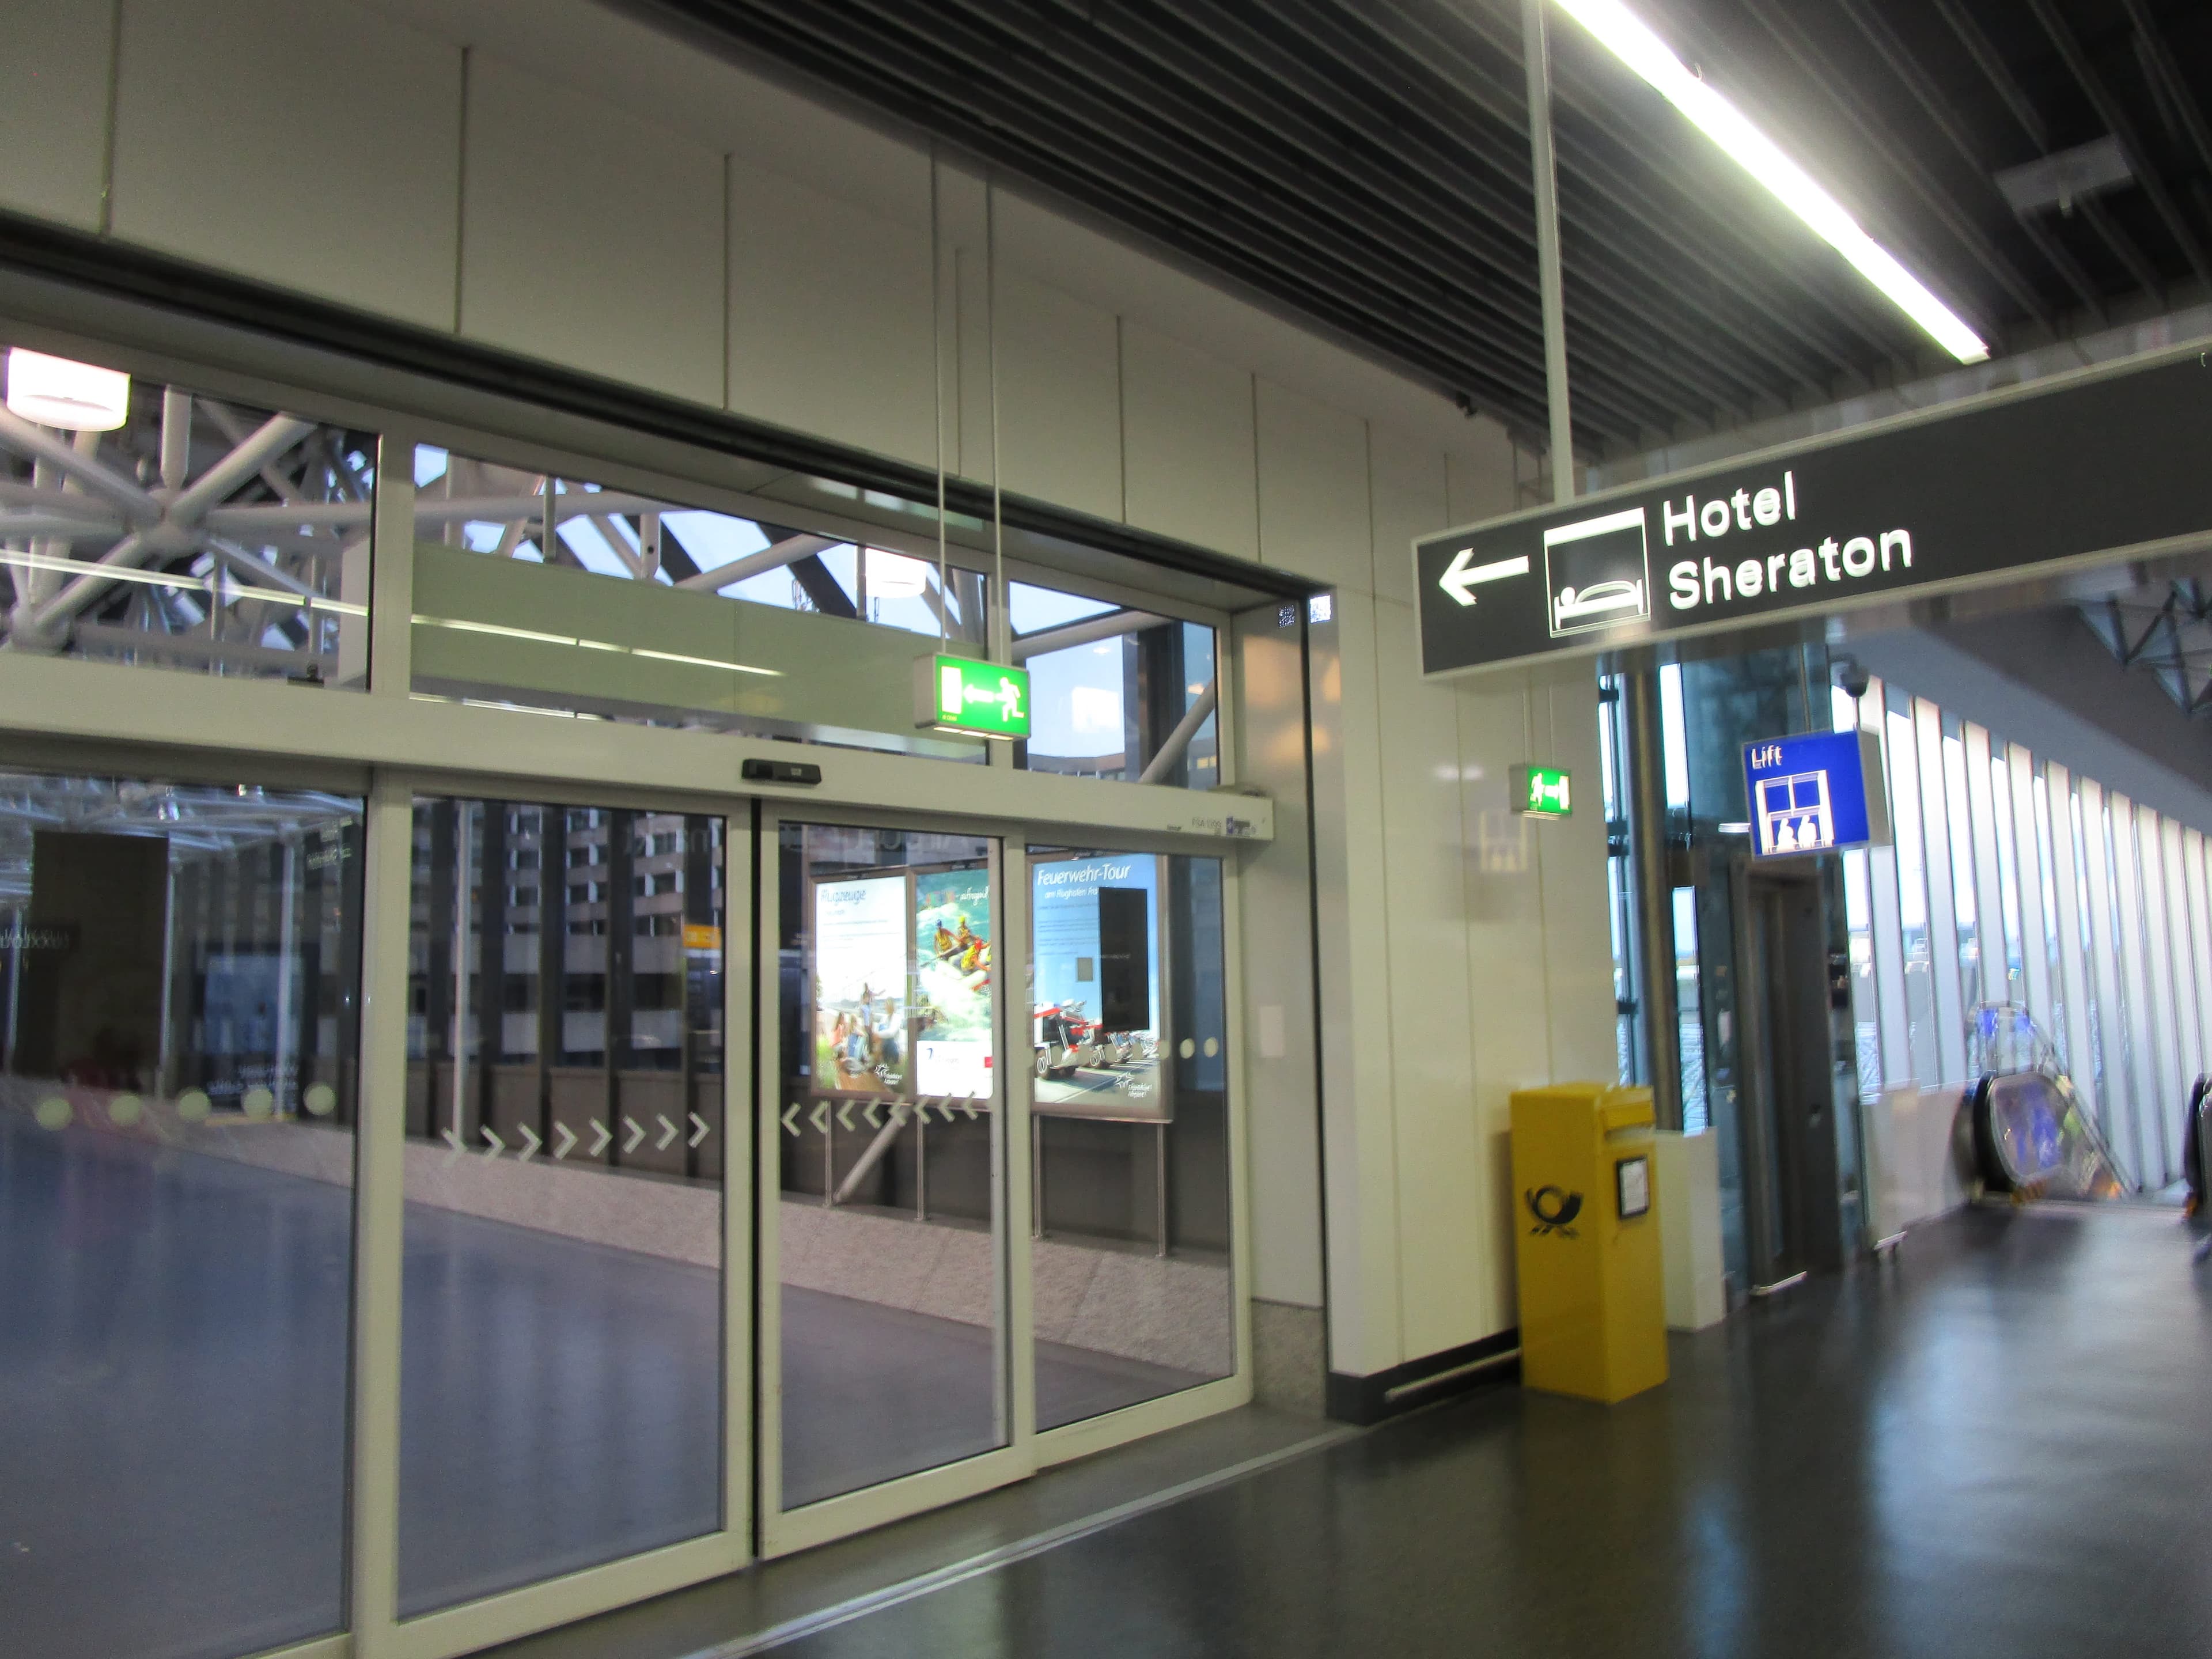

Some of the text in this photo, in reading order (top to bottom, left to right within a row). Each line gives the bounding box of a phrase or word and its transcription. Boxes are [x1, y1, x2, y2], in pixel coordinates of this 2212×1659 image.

[1664, 471, 1796, 546] Hotel
[1669, 528, 1912, 610] Sheraton
[1751, 745, 1782, 770] Lift
[1038, 863, 1131, 885] Feuerwehr-Tour
[1056, 888, 1085, 900] Flughafen
